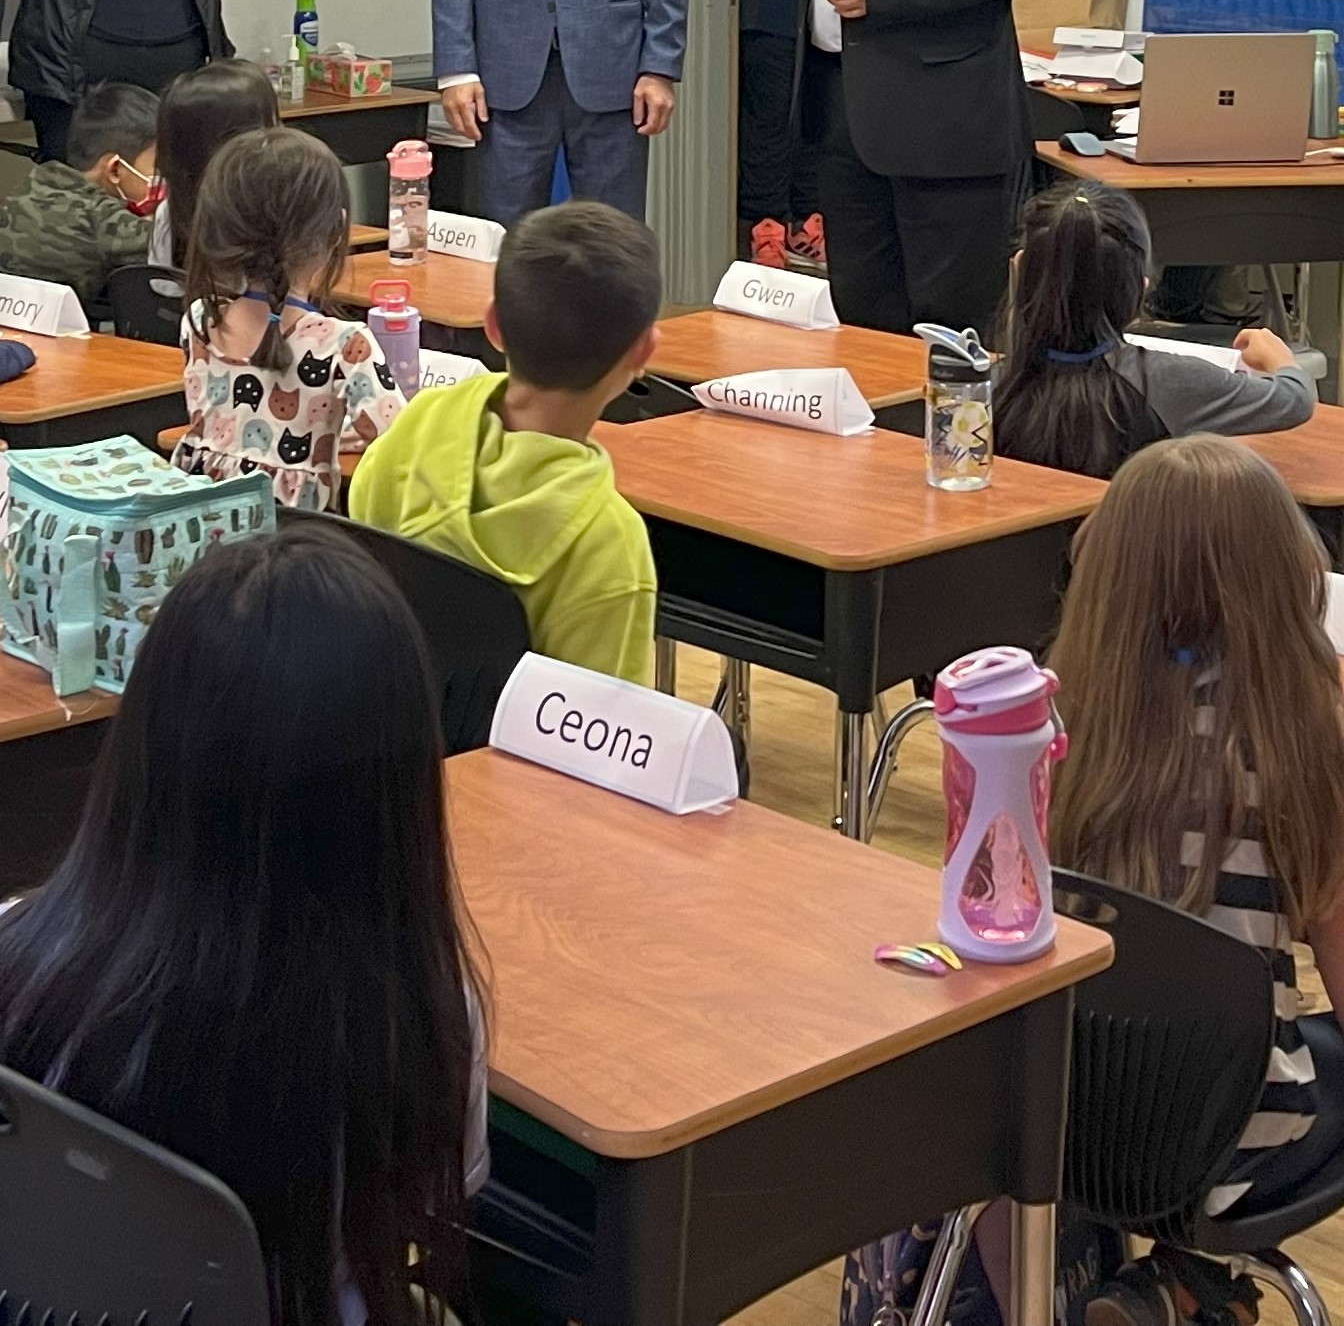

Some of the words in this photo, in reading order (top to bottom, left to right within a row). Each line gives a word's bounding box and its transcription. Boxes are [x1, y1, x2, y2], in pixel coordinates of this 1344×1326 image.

[427, 222, 476, 249] Aspen
[743, 279, 795, 308] Gwen
[707, 381, 822, 420] Channing
[536, 692, 653, 769] Ceona
